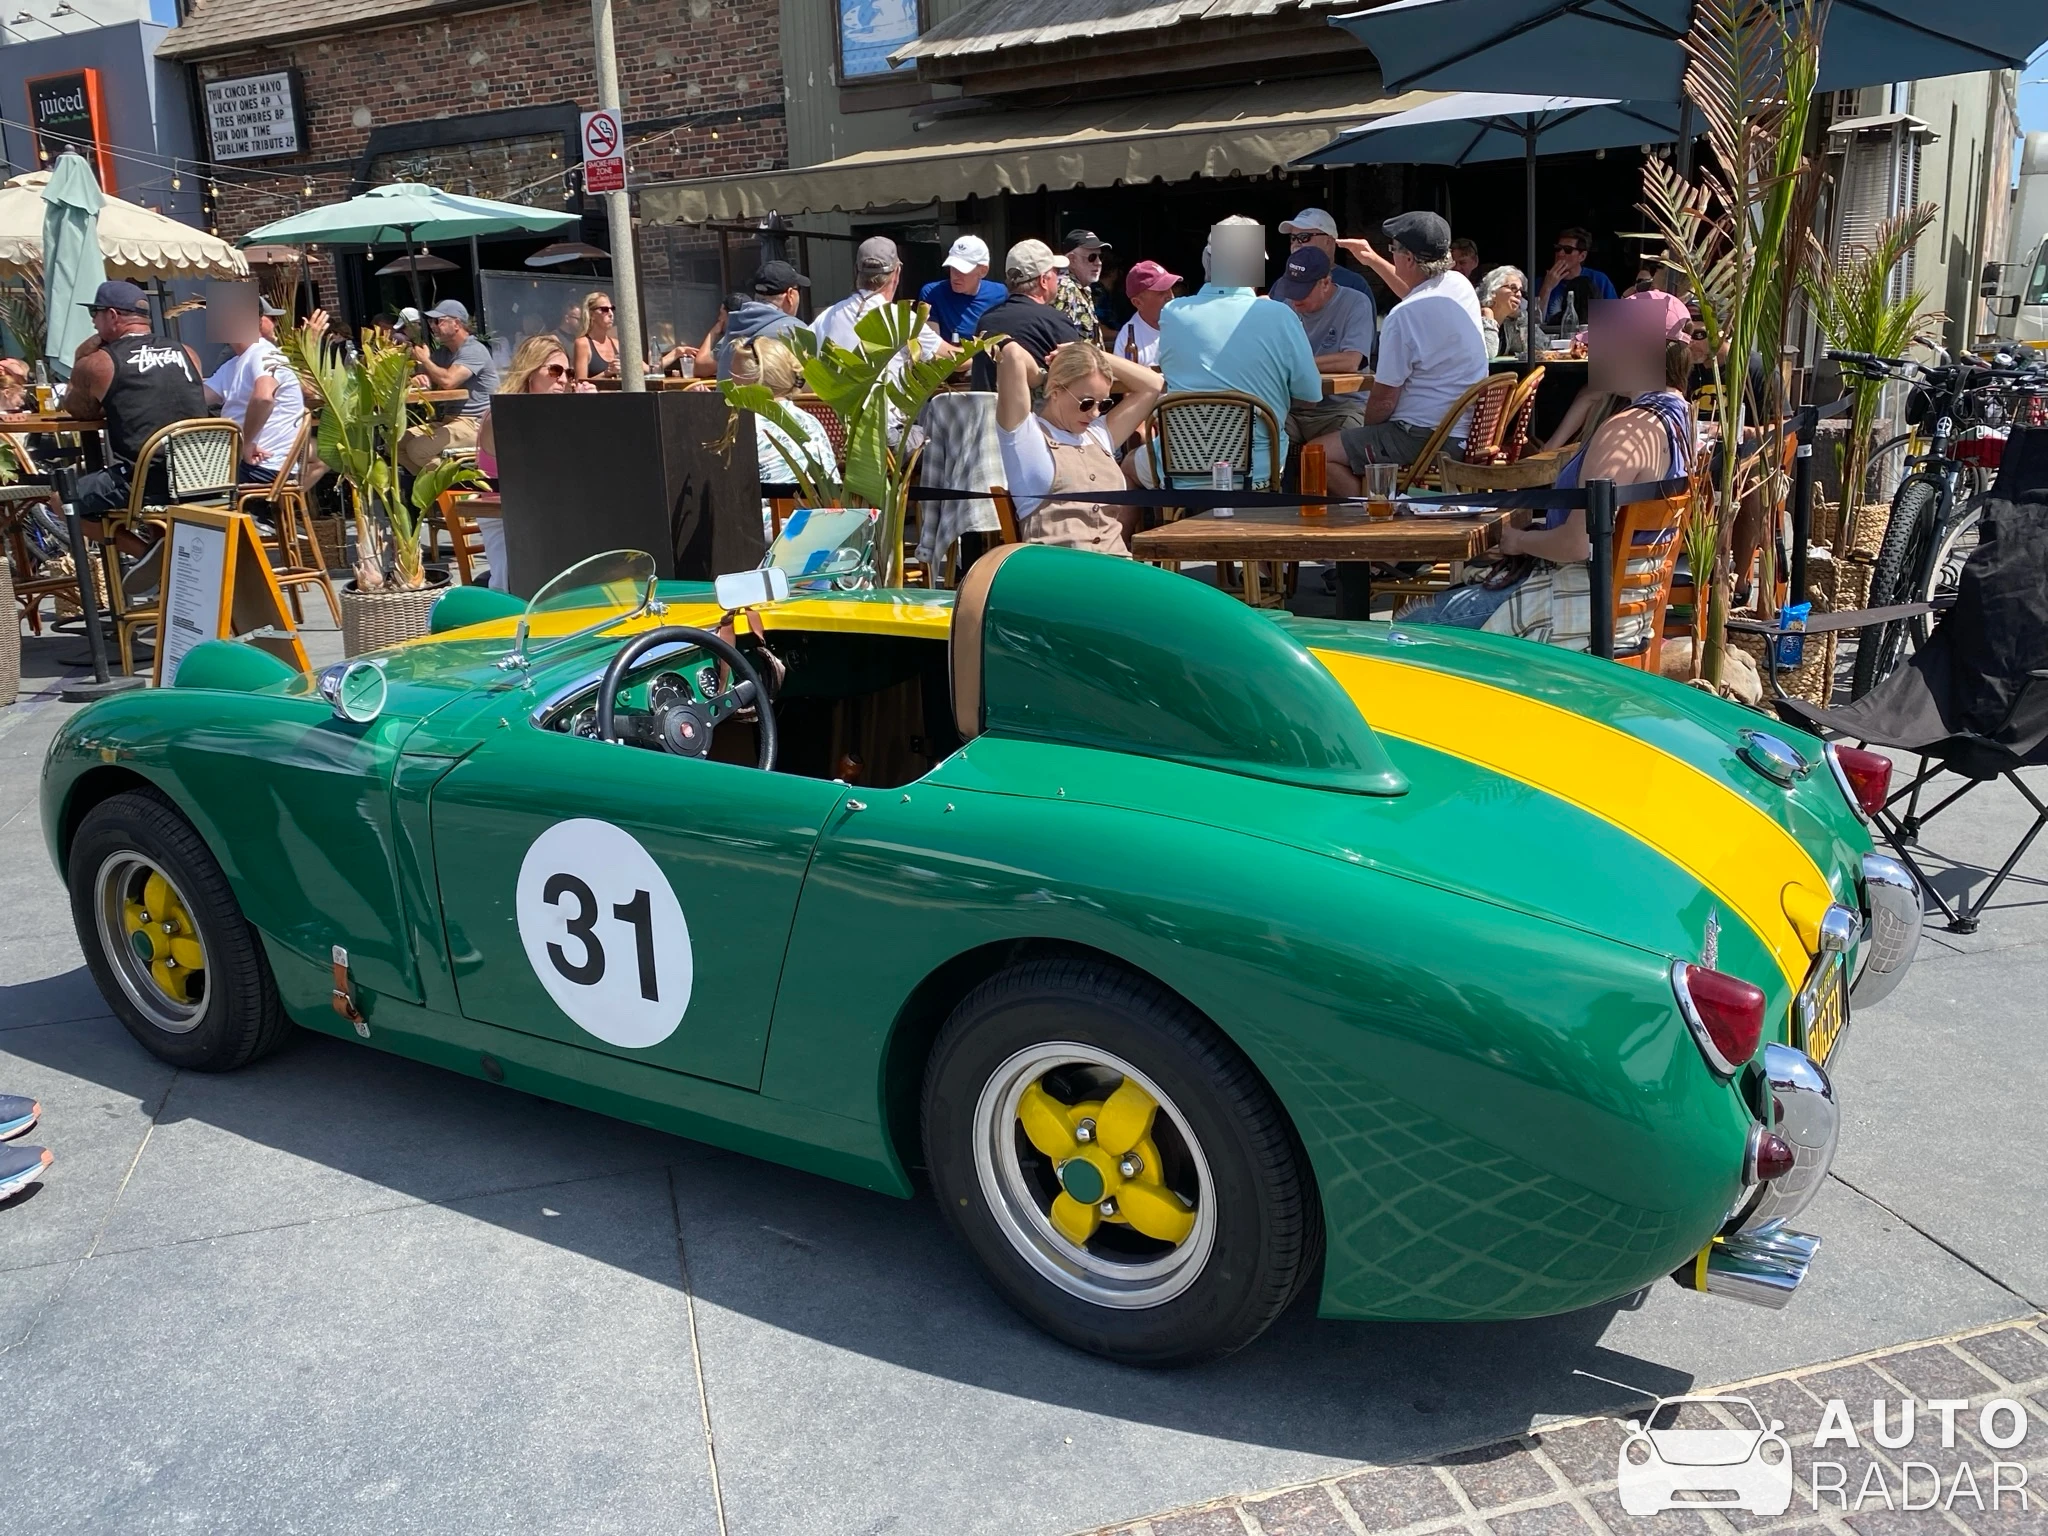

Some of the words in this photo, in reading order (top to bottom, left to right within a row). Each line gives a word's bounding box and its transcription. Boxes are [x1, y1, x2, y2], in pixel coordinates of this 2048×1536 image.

[207, 90, 221, 101] THU
[224, 86, 246, 98] CINCO
[248, 84, 257, 95] DE
[260, 81, 281, 94] MAYO
[39, 87, 84, 122] juiced
[212, 102, 237, 114] LUCKY
[239, 98, 258, 111] ONES
[260, 97, 270, 108] 4P
[215, 116, 234, 128] TRES
[236, 111, 271, 126] HOMBRES
[274, 110, 284, 120] 8P
[213, 131, 228, 142] SUN
[230, 129, 248, 140] DOIN
[252, 125, 270, 137] TIME
[216, 142, 249, 156] SUBLIME
[251, 138, 283, 152] TRIBUTE
[285, 137, 294, 148] 2P
[587, 159, 620, 169] SMOKE-FREE
[596, 167, 612, 176] ZONE
[543, 872, 660, 1003] 31
